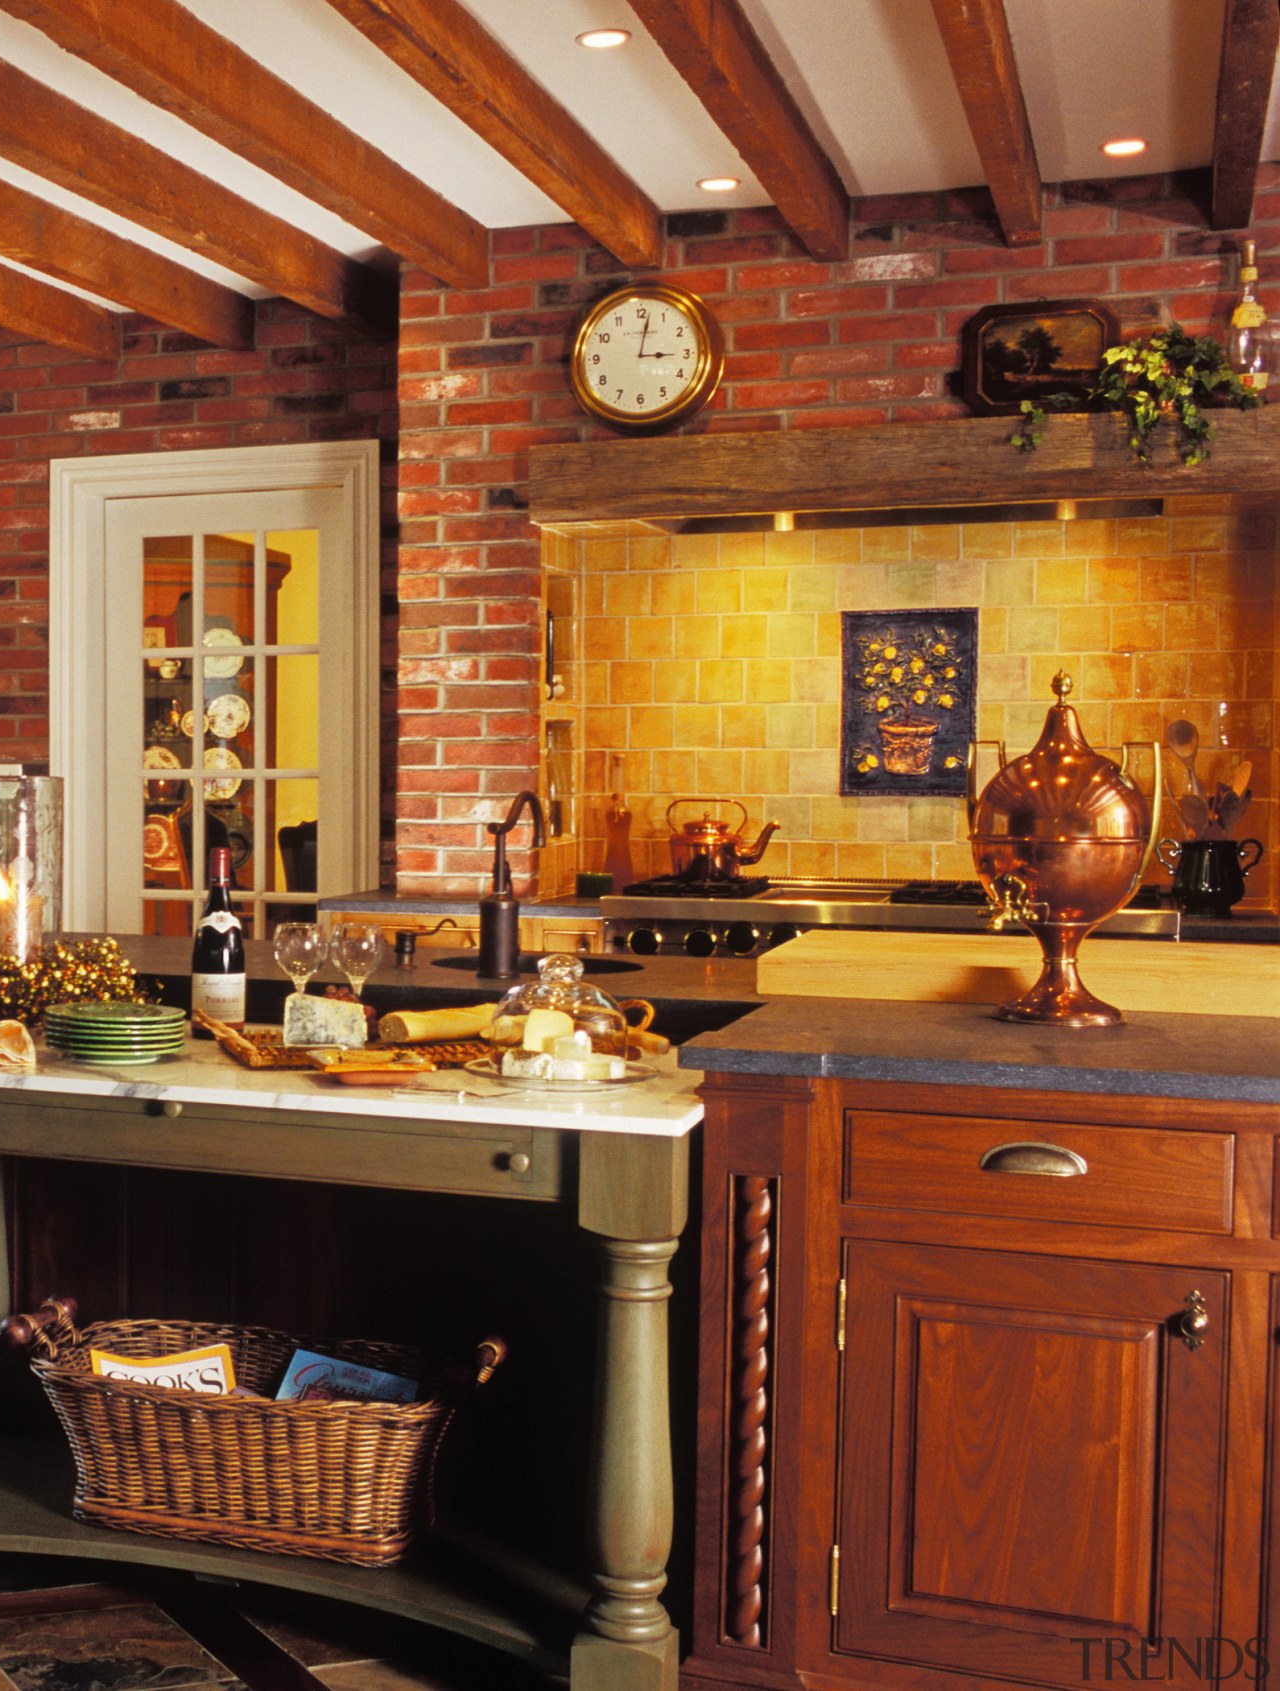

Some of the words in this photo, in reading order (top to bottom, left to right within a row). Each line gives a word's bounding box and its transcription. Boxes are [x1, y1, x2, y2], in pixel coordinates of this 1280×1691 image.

[636, 308, 646, 319] 12
[614, 316, 623, 326] 11
[676, 327, 683, 337] 2
[598, 333, 610, 343] 10
[592, 354, 600, 364] 9
[683, 349, 690, 359] 3
[676, 368, 683, 378] 4
[599, 375, 607, 386] 8
[616, 389, 623, 400] 7
[659, 387, 666, 397] 5
[636, 393, 644, 404] 6
[107, 1367, 224, 1395] OK'S
